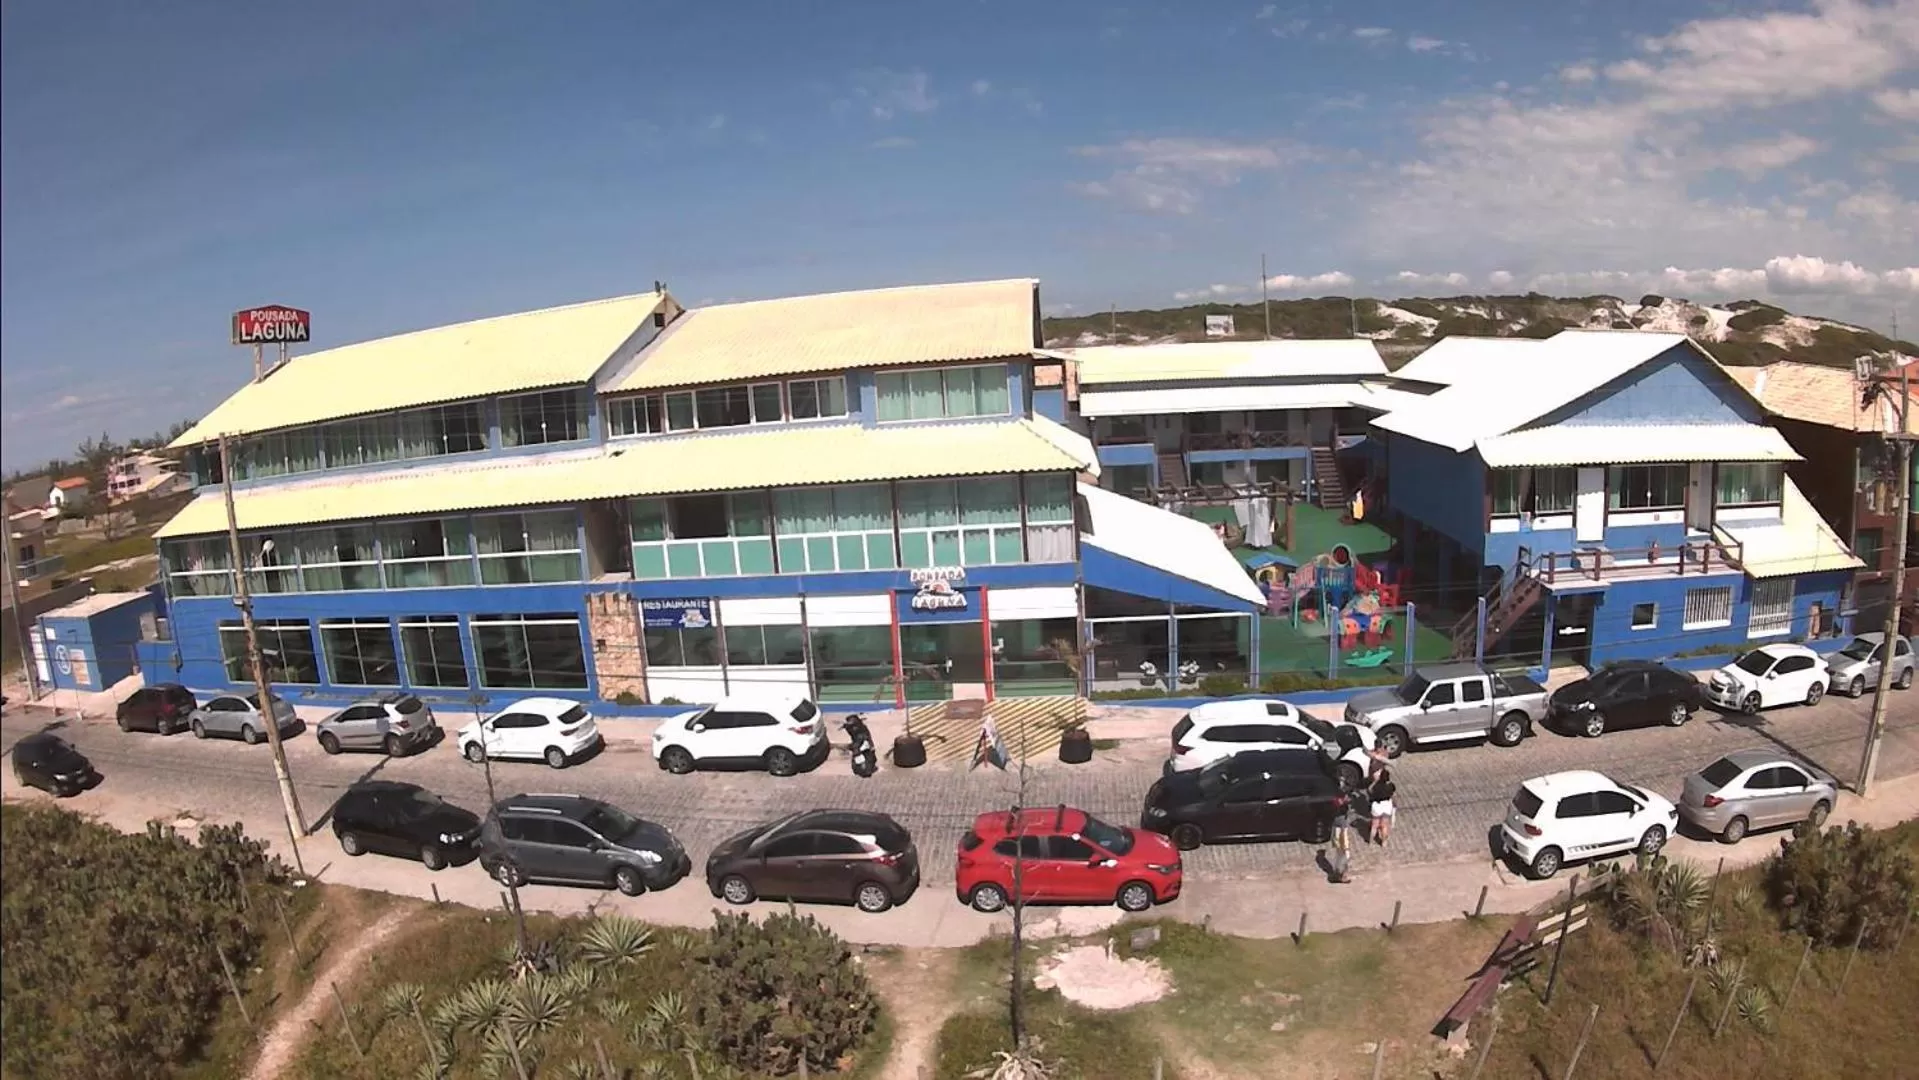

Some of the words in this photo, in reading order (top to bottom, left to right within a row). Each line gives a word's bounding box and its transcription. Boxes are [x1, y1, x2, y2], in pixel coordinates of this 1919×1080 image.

[250, 310, 299, 321] POUSADA
[241, 322, 307, 340] LAGUNA
[643, 599, 708, 609] RESTAURANTE
